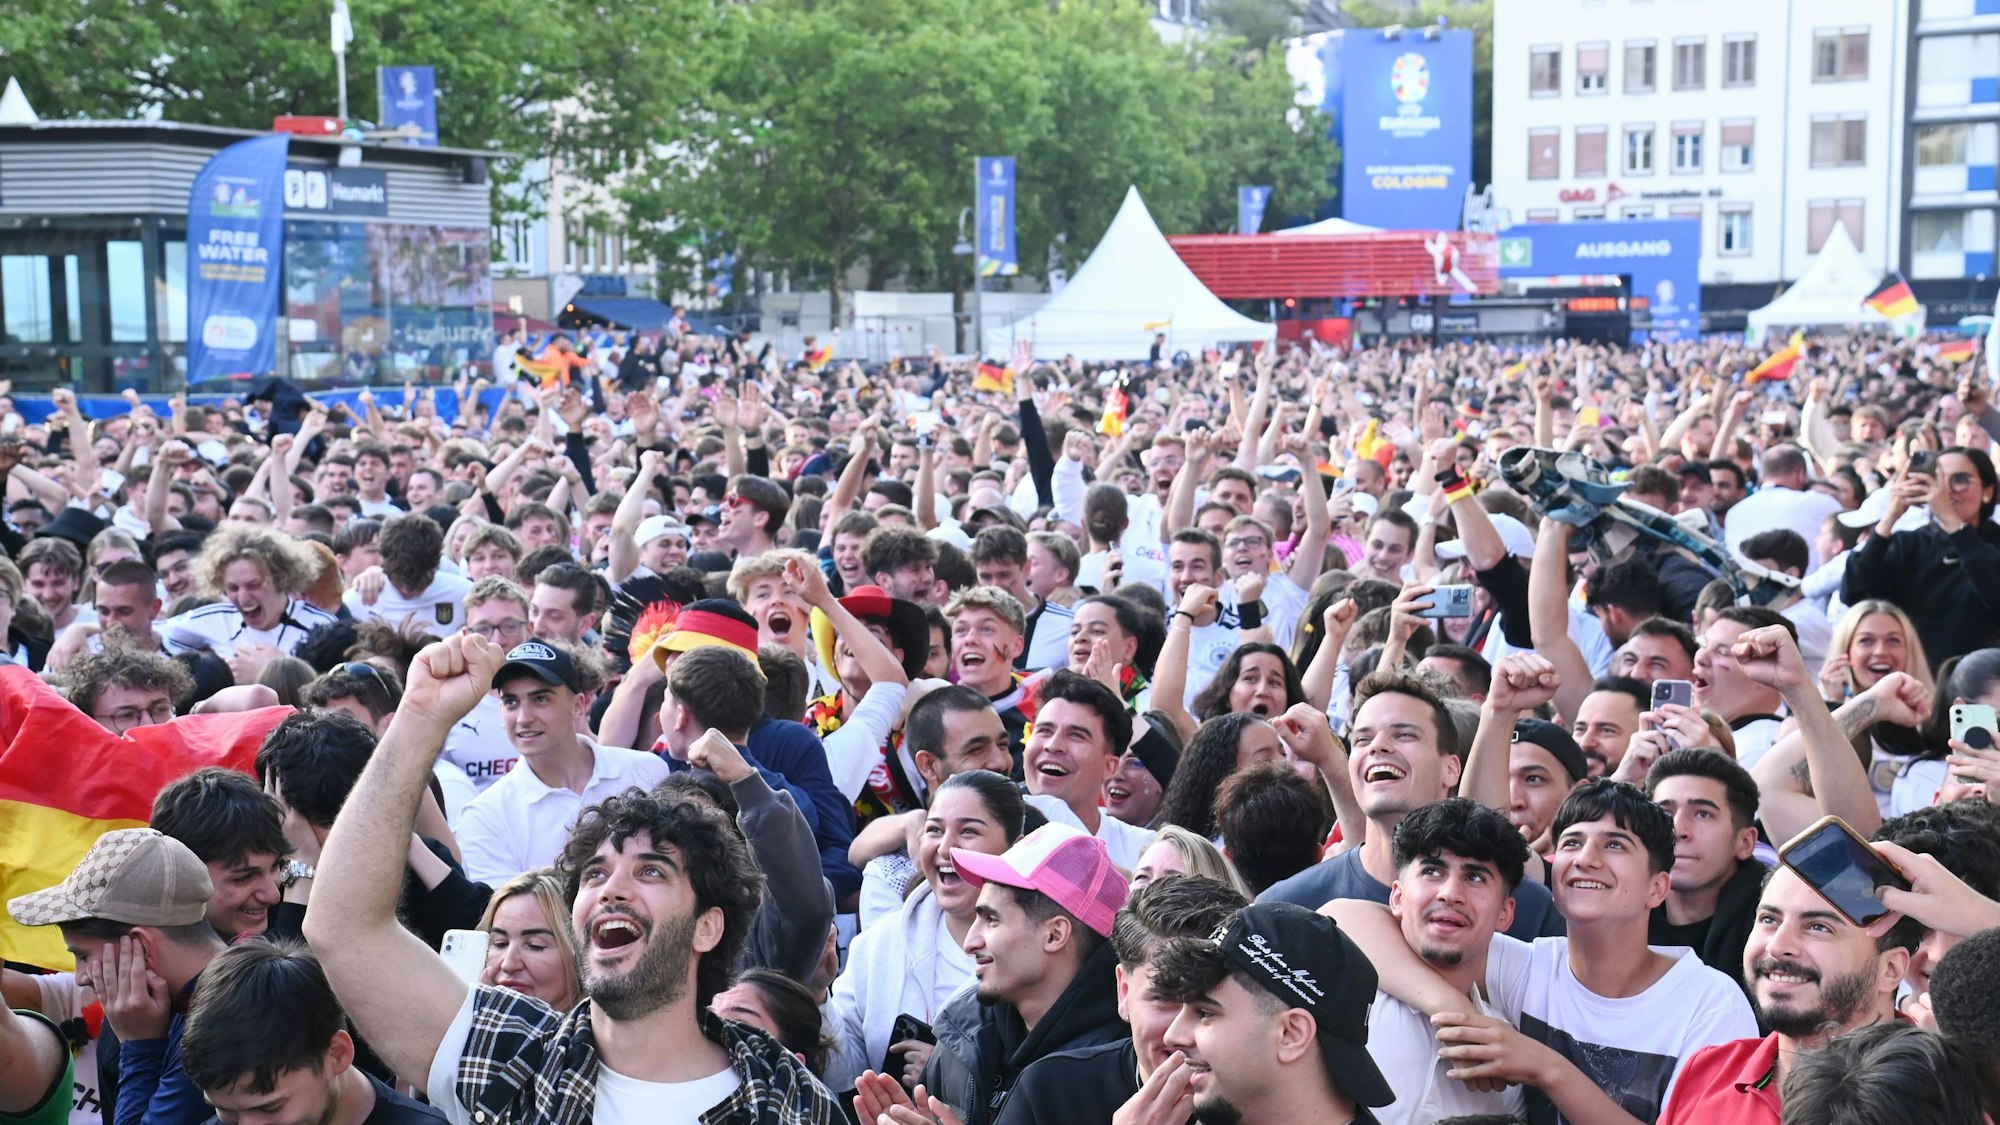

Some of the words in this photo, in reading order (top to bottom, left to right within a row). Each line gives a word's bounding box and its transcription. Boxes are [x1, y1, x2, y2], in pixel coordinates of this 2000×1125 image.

[332, 181, 385, 203] Heumarkt
[1371, 175, 1448, 190] COLOGNE
[1559, 188, 1597, 203] GAG
[208, 228, 260, 247] FREE
[197, 243, 269, 263] WATER
[1575, 240, 1672, 259] AUSGANG
[465, 758, 519, 777] CHEC
[1238, 943, 1262, 958] with
[1251, 956, 1278, 974] spirit
[1272, 972, 1291, 980] of
[1281, 978, 1316, 1005] tomorrow
